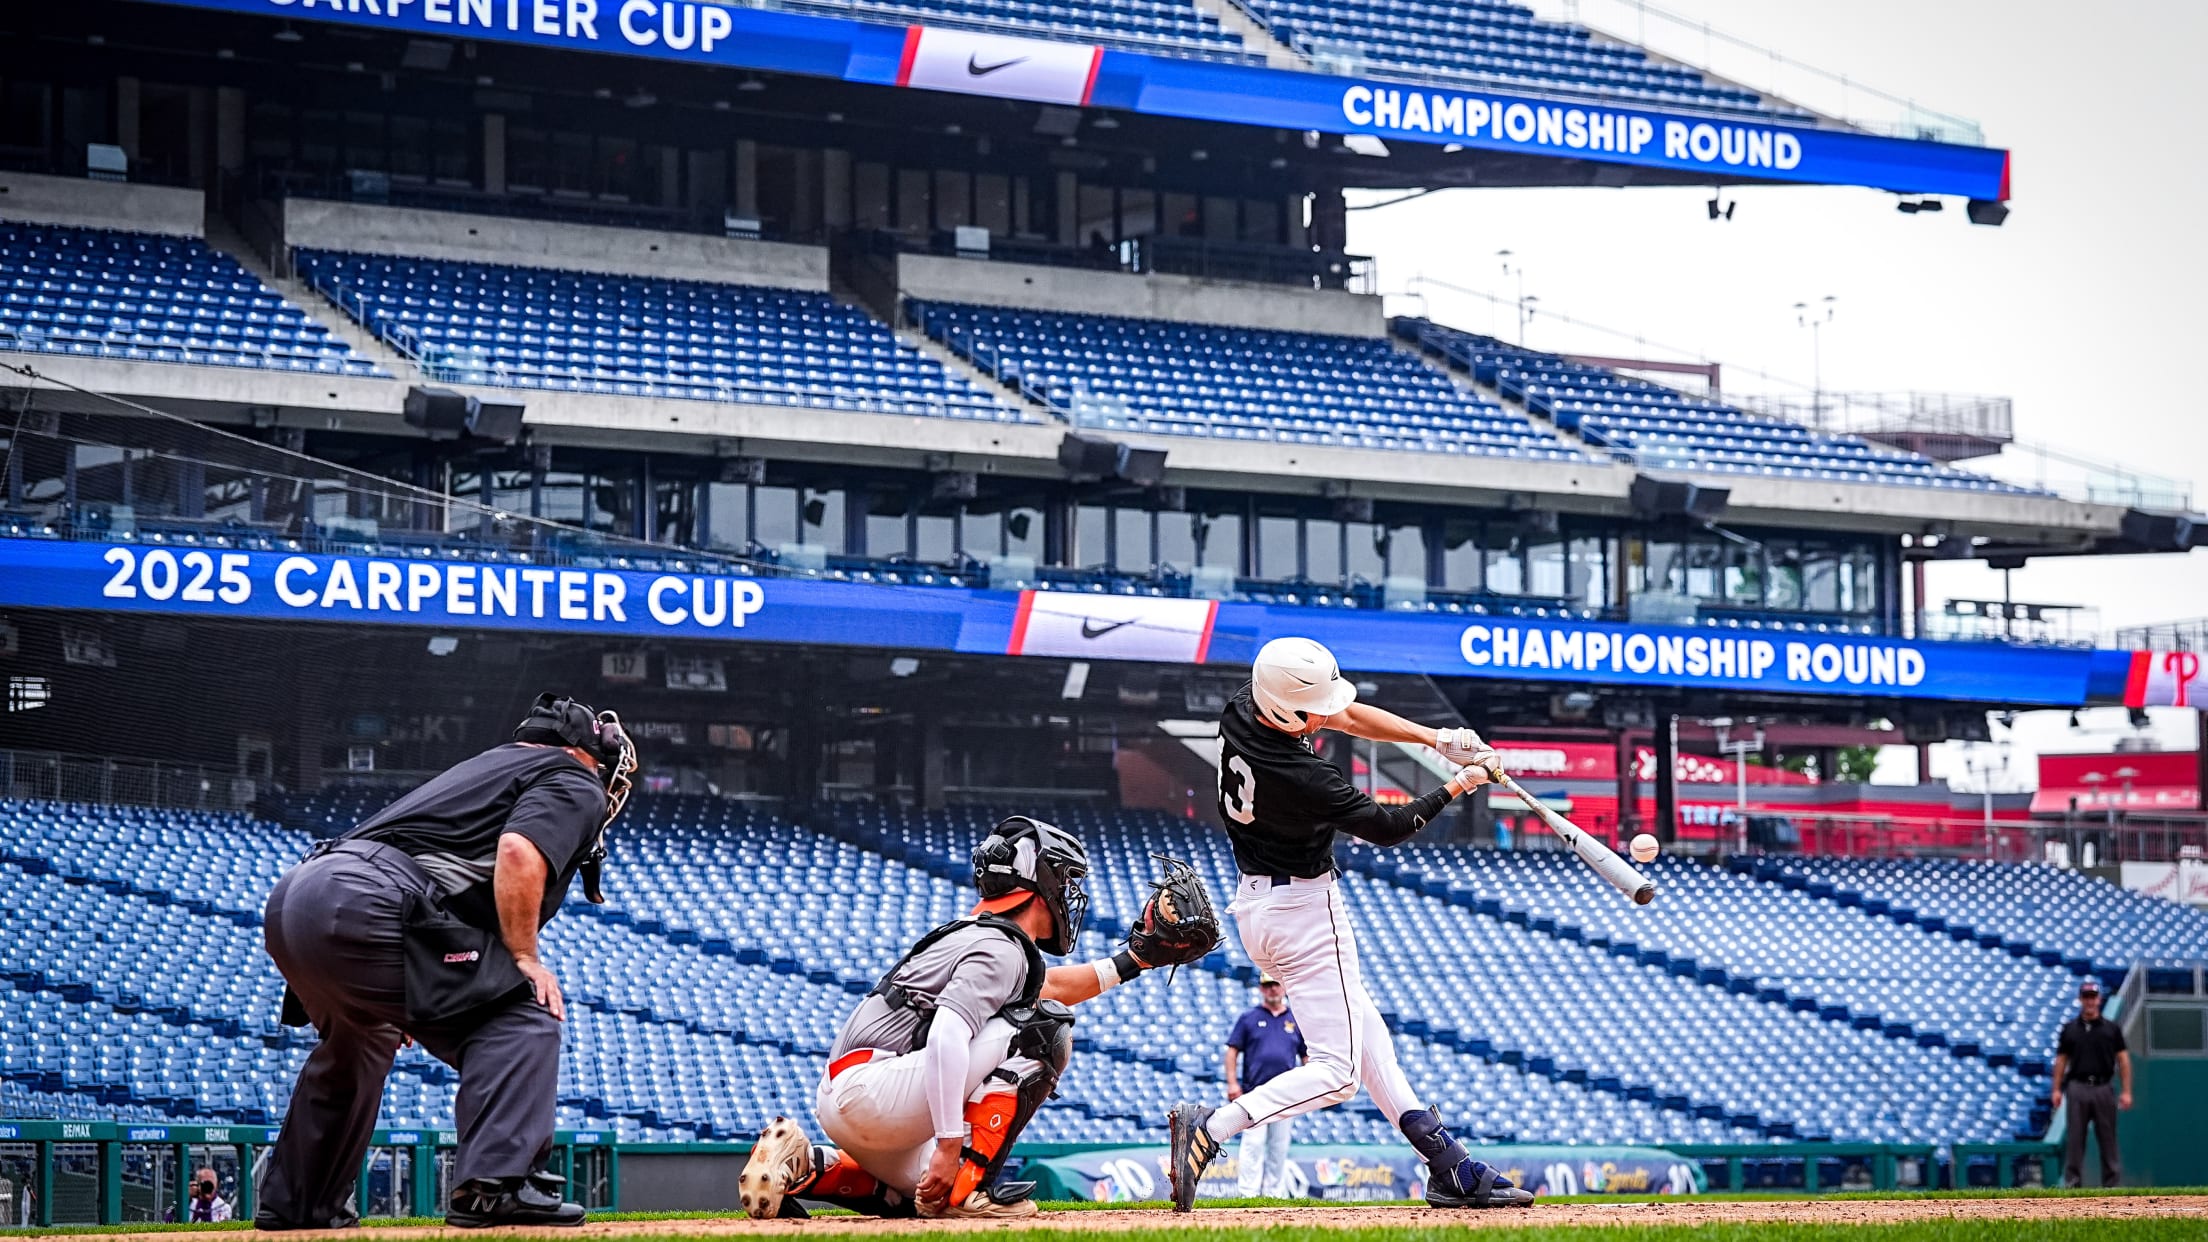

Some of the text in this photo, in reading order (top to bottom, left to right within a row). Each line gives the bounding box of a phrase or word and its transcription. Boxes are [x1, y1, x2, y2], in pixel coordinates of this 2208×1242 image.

[267, 0, 733, 53] ENTER CUP
[1342, 85, 1802, 170] CHAMPIONSHIP ROUND
[102, 547, 766, 628] 2025 CARPENTER CUP
[1459, 624, 1927, 686] CHAMPIONSHIP ROUND
[2163, 652, 2200, 707] P
[62, 1123, 92, 1138] RE/MAX
